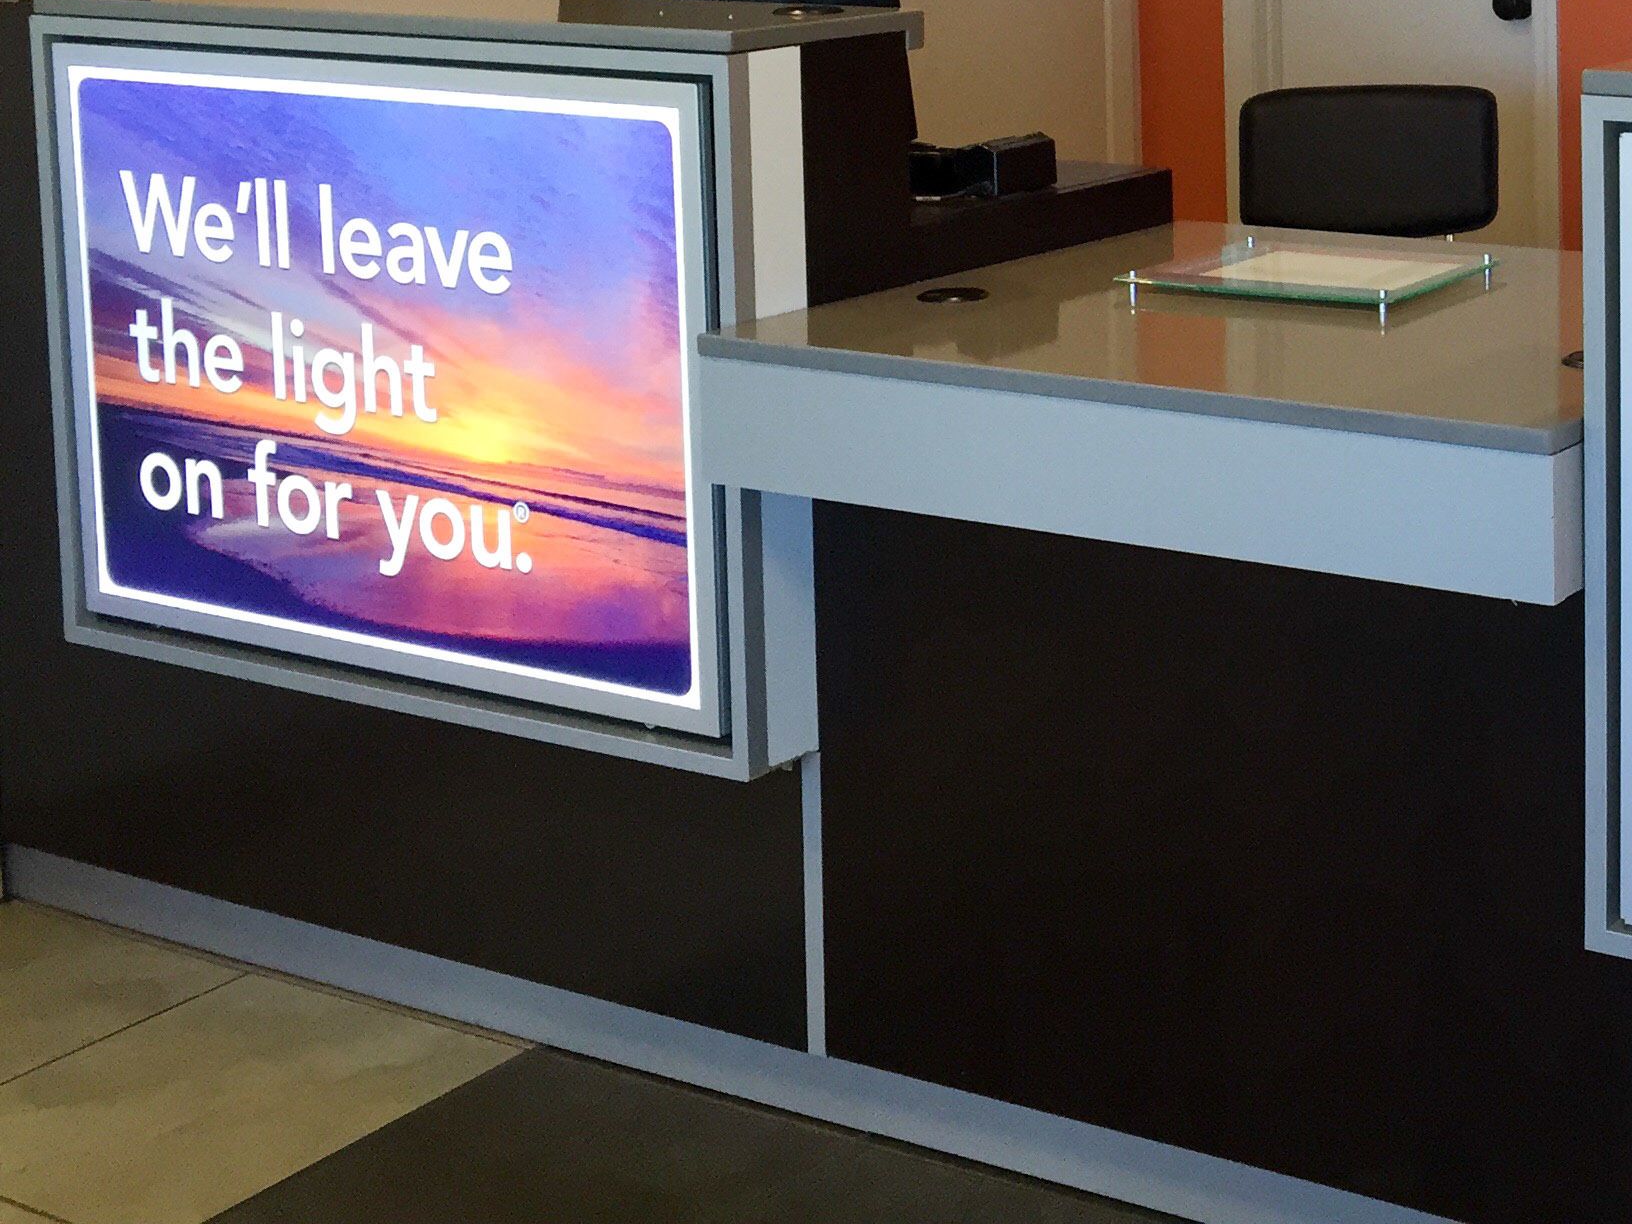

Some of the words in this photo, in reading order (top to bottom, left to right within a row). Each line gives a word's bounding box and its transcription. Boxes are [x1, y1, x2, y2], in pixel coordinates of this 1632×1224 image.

[120, 171, 289, 268] We'll
[320, 184, 512, 293] leave
[130, 298, 243, 392] the
[271, 312, 436, 434] light
[141, 453, 223, 518] on
[248, 440, 351, 538] for
